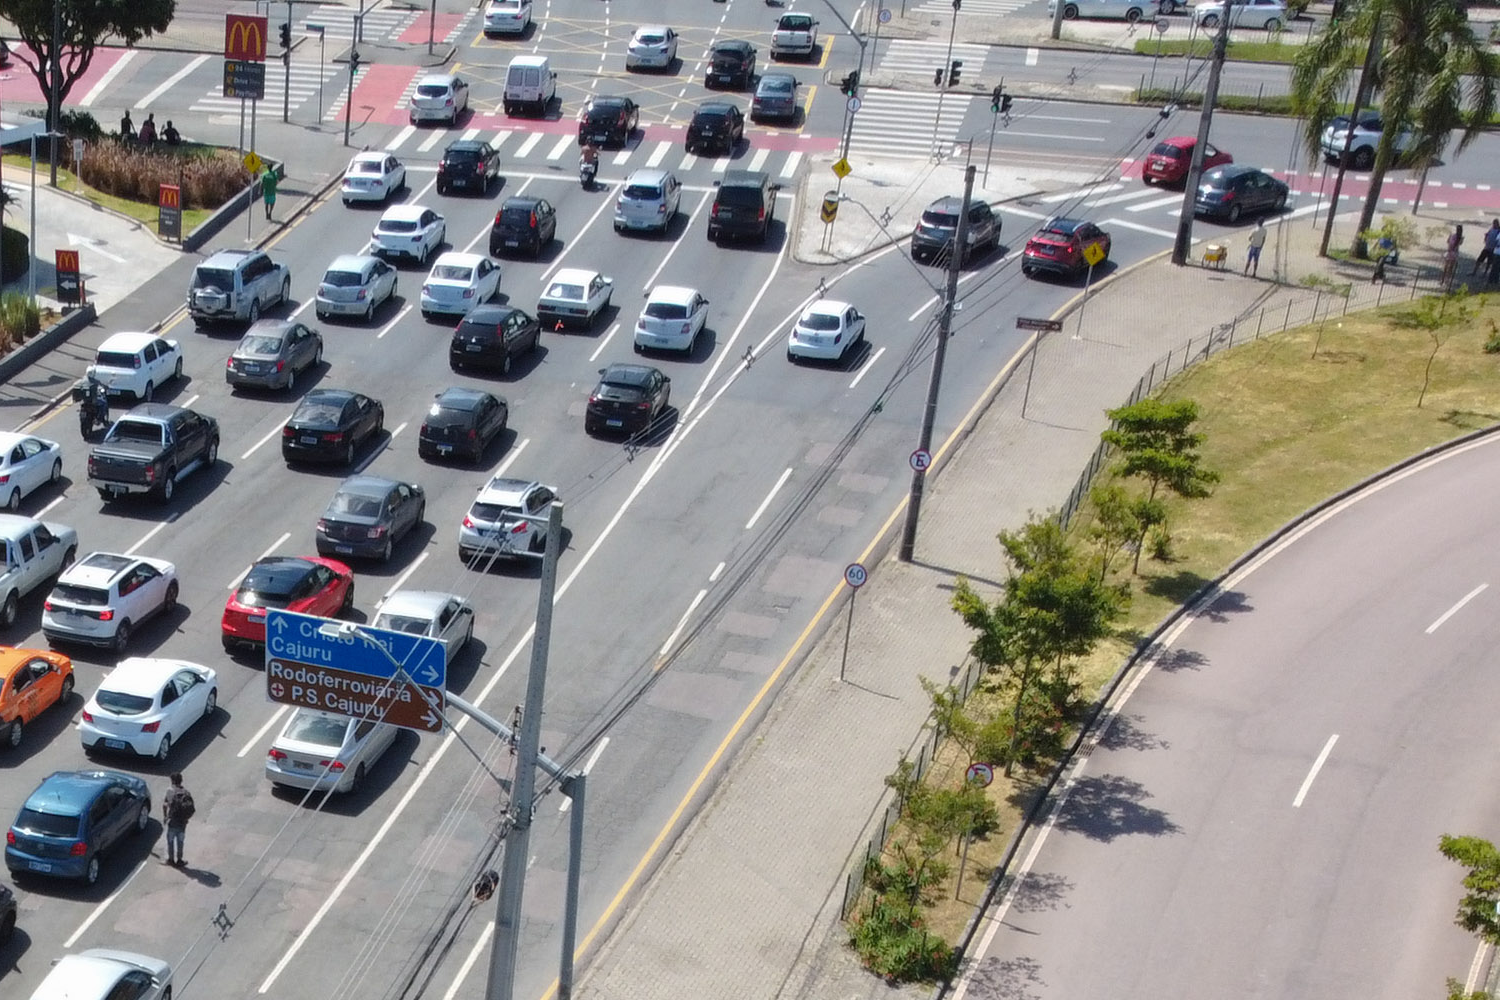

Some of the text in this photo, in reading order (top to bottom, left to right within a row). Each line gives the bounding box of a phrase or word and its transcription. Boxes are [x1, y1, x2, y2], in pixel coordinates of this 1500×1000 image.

[849, 568, 864, 580] 60
[271, 637, 332, 662] Cajuru
[270, 661, 412, 703] Rodoferroviária
[291, 685, 385, 718] P.S. Cajuru
